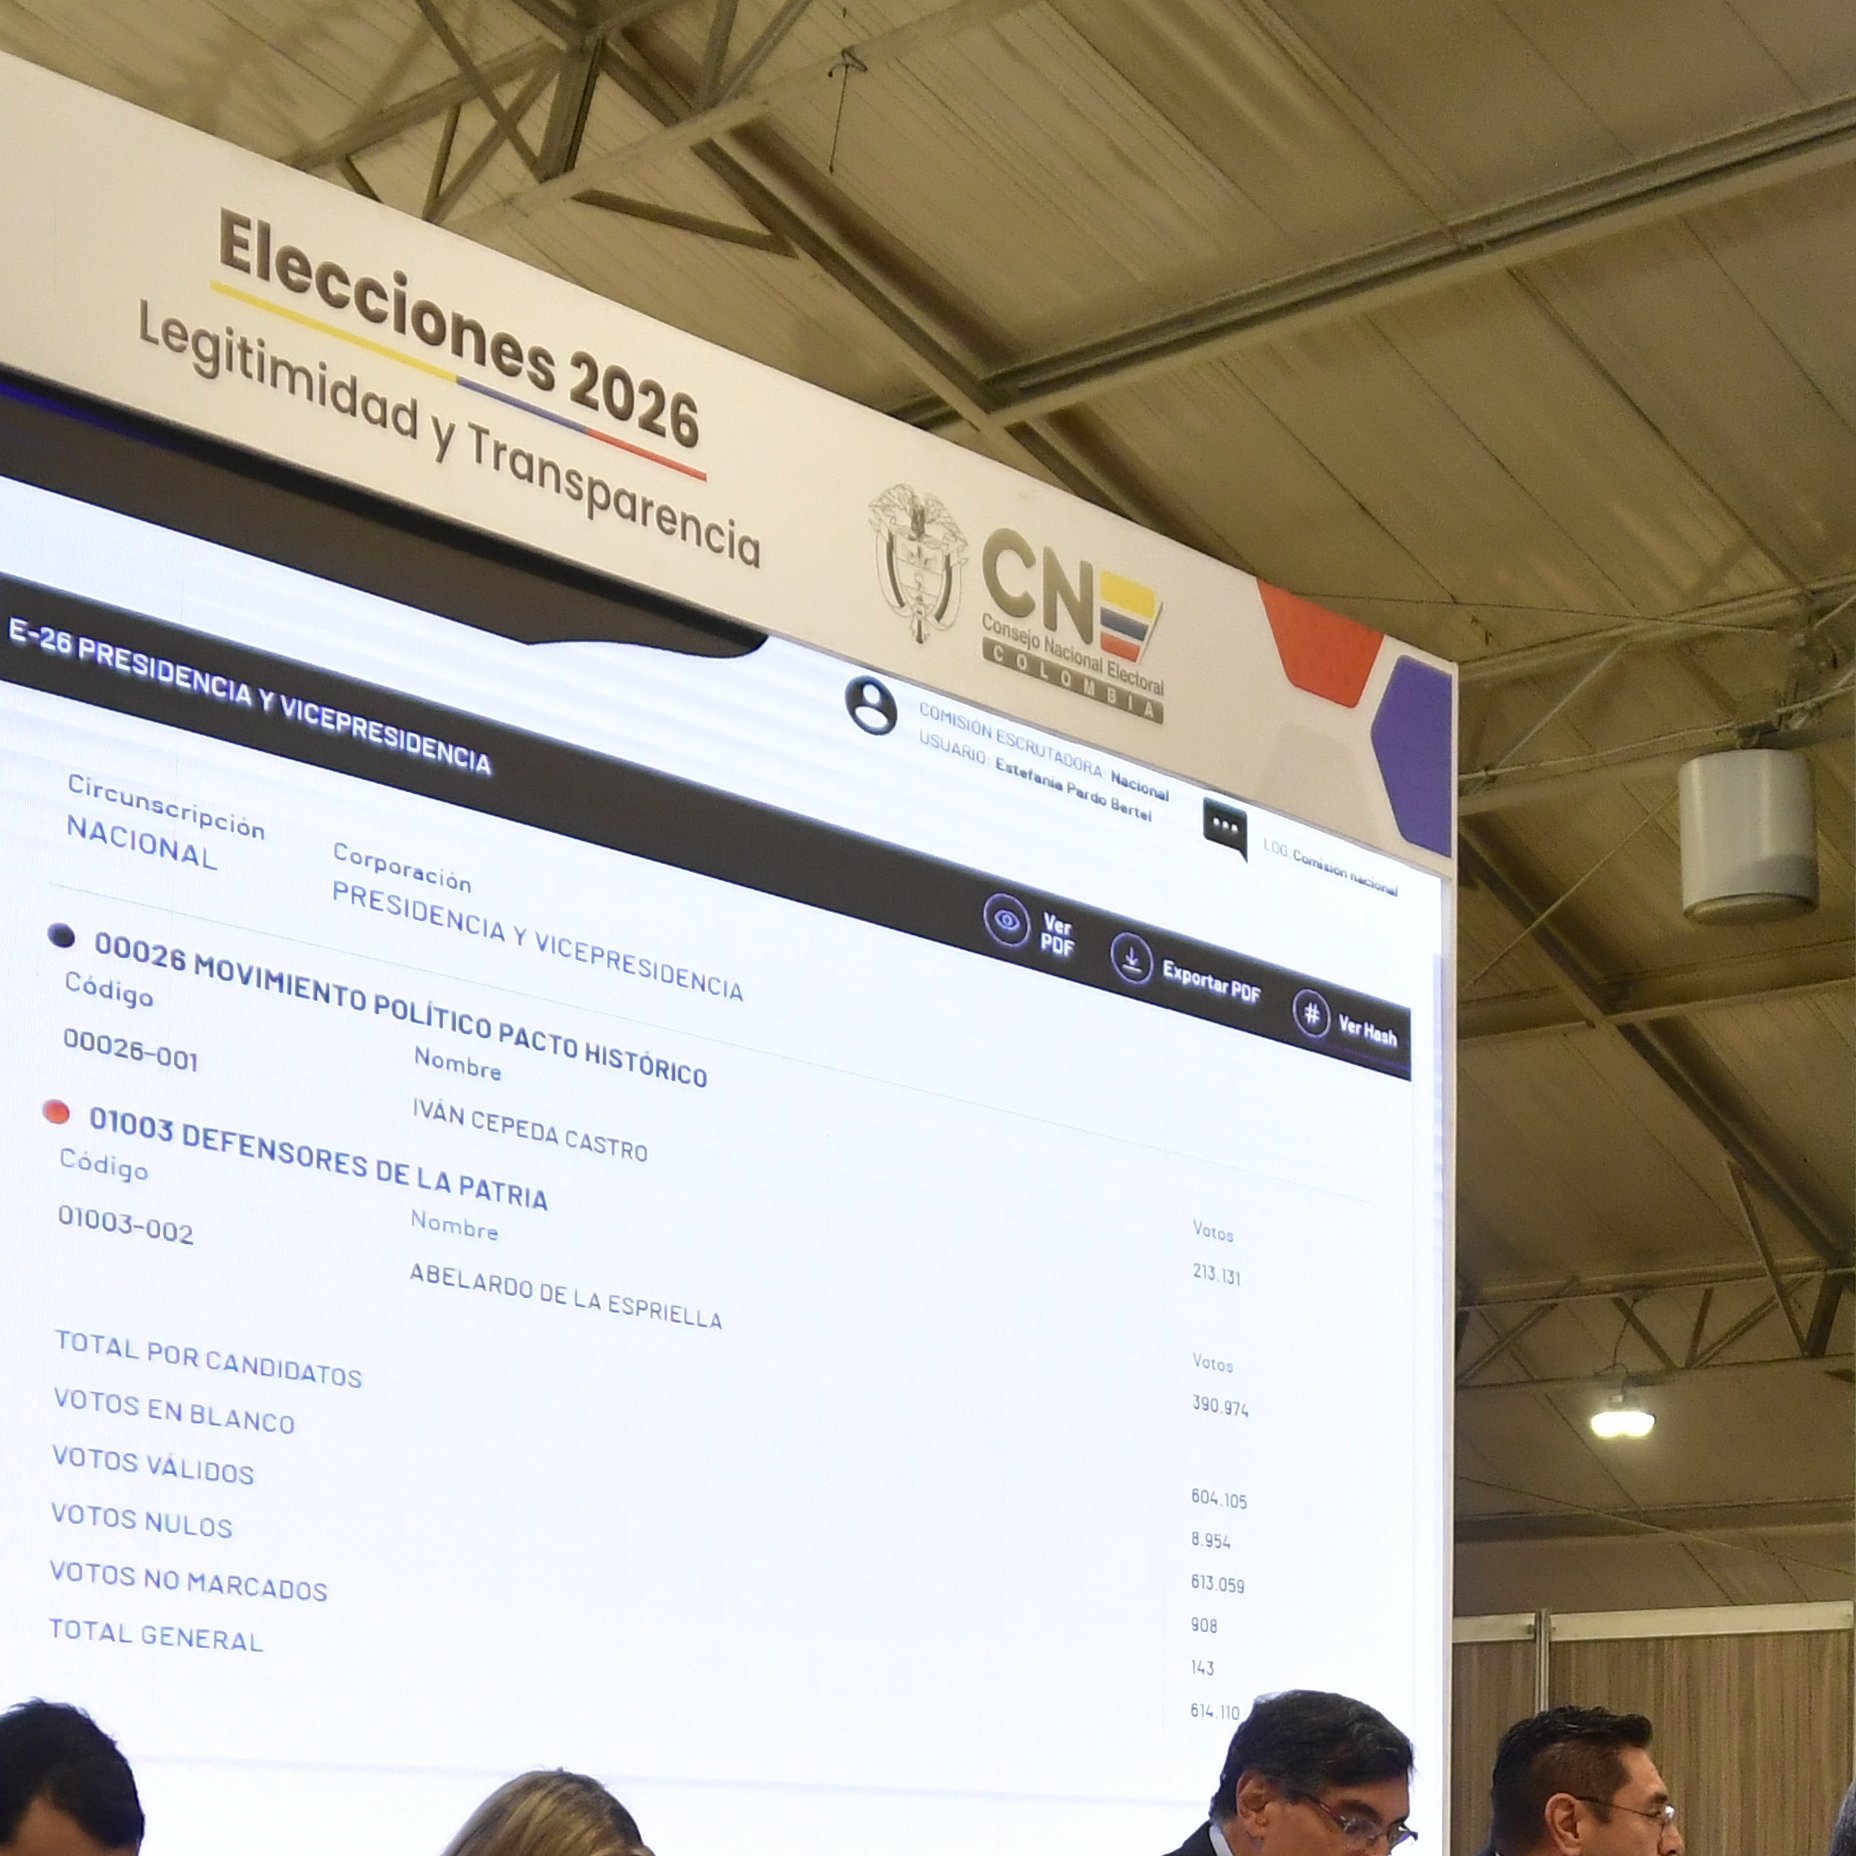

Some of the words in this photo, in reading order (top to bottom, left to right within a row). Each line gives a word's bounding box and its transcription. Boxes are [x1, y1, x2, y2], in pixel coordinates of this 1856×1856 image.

[218, 206, 556, 393] Elecciones
[569, 350, 701, 450] 2026
[138, 298, 418, 442] Legitimidad
[430, 413, 456, 464] y
[467, 420, 761, 571] Transparencia
[8, 615, 72, 657] E-26
[77, 636, 254, 709] PRESIDENCIA
[258, 688, 276, 714] Y
[279, 696, 493, 778] VICEPRESIDENCIA
[982, 612, 1041, 650] Consejo
[1044, 635, 1104, 674] Nacional
[1107, 661, 1164, 697] Electoral
[919, 701, 993, 740] COMISIÓN
[1110, 769, 1170, 802] Nacional
[1067, 781, 1107, 807] Pardo
[1111, 799, 1153, 823] Bertel
[68, 773, 267, 841] Circunscripción
[332, 842, 473, 896] Corporación
[1293, 849, 1348, 879] Comisión
[1350, 871, 1398, 897] nacional
[66, 813, 218, 872] NACIONAL
[332, 879, 506, 943] PRESIDENCIA
[513, 923, 529, 946] Y
[535, 931, 745, 1004] VICEPRESIDENCIA
[1040, 934, 1075, 958] PDF
[1043, 912, 1073, 938] Ver
[64, 969, 154, 1009] Código
[414, 1045, 503, 1083] Nombre
[94, 931, 187, 972] 00026
[194, 952, 368, 1012] MOVIMIENTO
[374, 993, 493, 1043] POLÍTICO
[499, 1022, 580, 1060] PACTO
[585, 1041, 709, 1090] HISTÓRICO
[1162, 958, 1229, 998] Exportar
[1231, 978, 1262, 1005] PDF
[1338, 1013, 1362, 1037] Ver
[1363, 1021, 1399, 1048] Hash
[63, 1027, 200, 1074] 00026-001
[413, 1096, 466, 1127] IVÁN
[471, 1109, 561, 1146] CEPEDA
[565, 1127, 649, 1163] CASTRO
[89, 1107, 175, 1143] 01003
[182, 1124, 368, 1180] DEFENSORES
[376, 1157, 410, 1187] DE
[417, 1165, 452, 1194] LA
[459, 1173, 549, 1212] PATRIA
[59, 1146, 150, 1184] Código
[410, 1208, 500, 1242] Nombre
[1192, 1351, 1235, 1374] Votos
[1192, 1219, 1235, 1244] Votos
[1192, 1262, 1243, 1288] 213.131
[57, 1204, 195, 1247] 01003-002
[410, 1263, 534, 1301] ABELARDO
[540, 1280, 569, 1304] DE
[574, 1286, 603, 1311] LA
[609, 1290, 724, 1331] ESPRIELLA
[1192, 1394, 1250, 1419] 390.974
[54, 1387, 140, 1418] VOTOS
[147, 1398, 183, 1422] EN
[190, 1403, 296, 1435] BLANCO
[1191, 1530, 1232, 1551] 8.954
[55, 1327, 141, 1361] TOTAL
[147, 1341, 200, 1368] POR
[206, 1349, 364, 1389] CANDIDATOS
[1191, 1487, 1248, 1511] 604.105
[51, 1502, 137, 1531] VOTOS
[145, 1510, 234, 1539] NULOS
[1190, 1616, 1219, 1635] 908
[52, 1444, 139, 1474] VOTOS
[146, 1452, 255, 1486] VÁLIDOS
[1190, 1573, 1246, 1596] 613.059
[49, 1616, 134, 1644] TOTAL
[141, 1624, 265, 1653] GENERAL
[50, 1559, 137, 1588] VOTOS
[144, 1568, 181, 1592] NO
[187, 1572, 329, 1604] MARCADOS
[1190, 1659, 1215, 1677] 143
